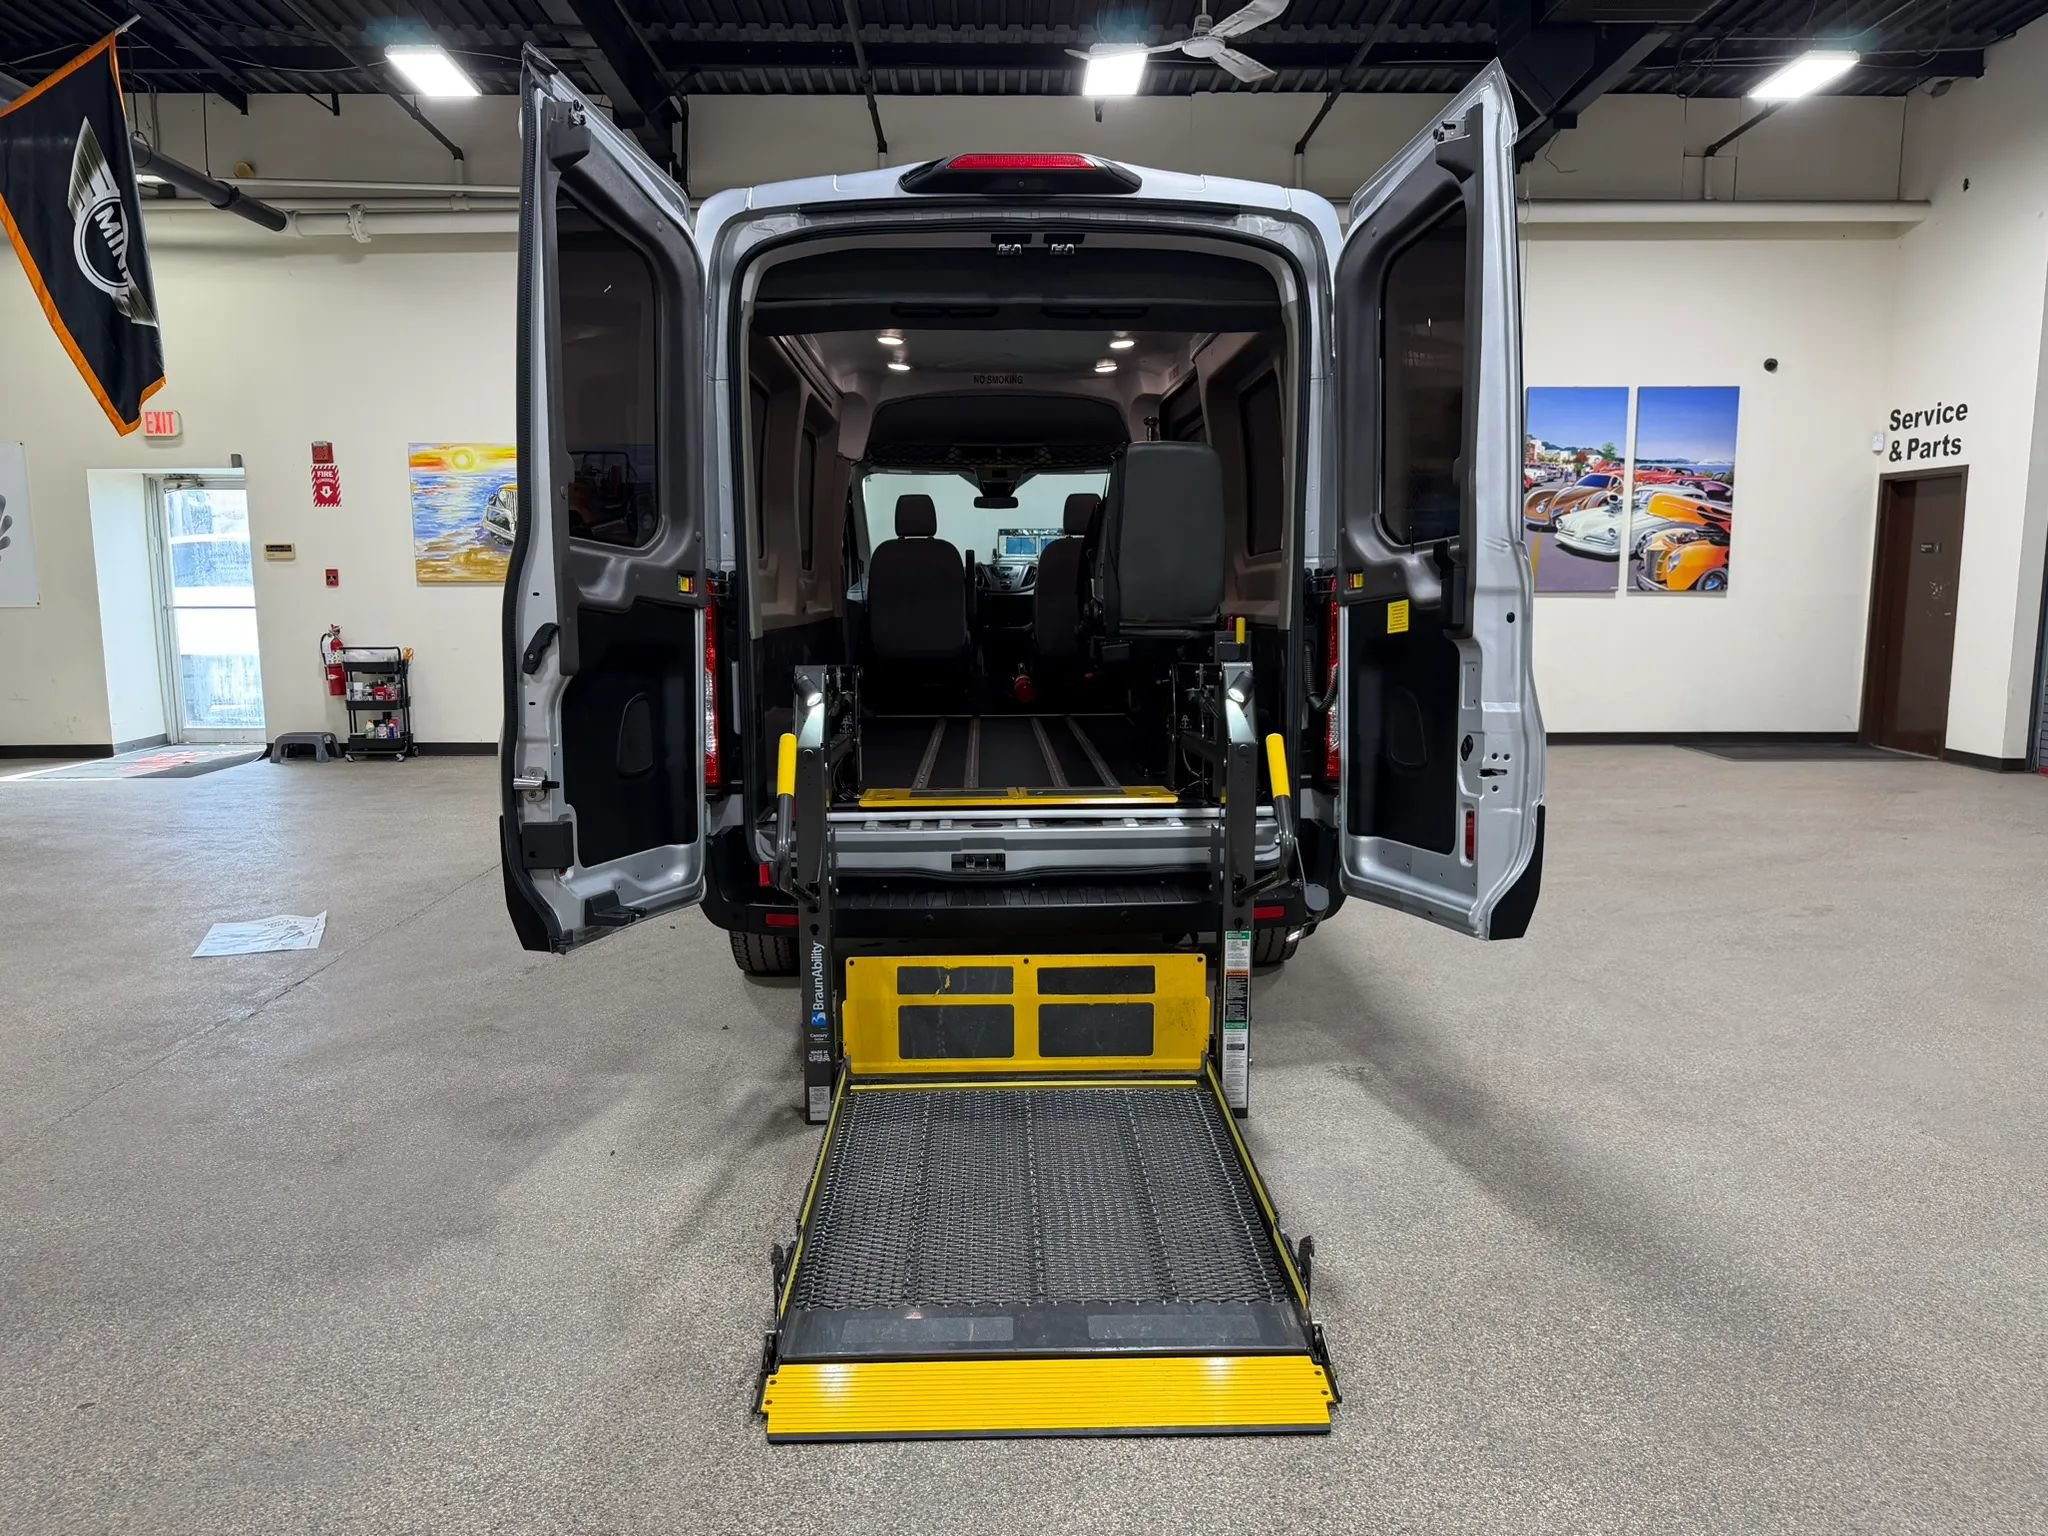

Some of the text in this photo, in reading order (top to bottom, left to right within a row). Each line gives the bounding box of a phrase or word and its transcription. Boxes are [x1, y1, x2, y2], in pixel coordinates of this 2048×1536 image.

[973, 375, 1023, 385] NO SMOKING
[144, 411, 174, 434] EXIT
[1889, 401, 1969, 432] Service
[1889, 433, 1963, 463] & Parts
[316, 470, 334, 478] FIRE
[810, 941, 825, 1010] BraunAbility
